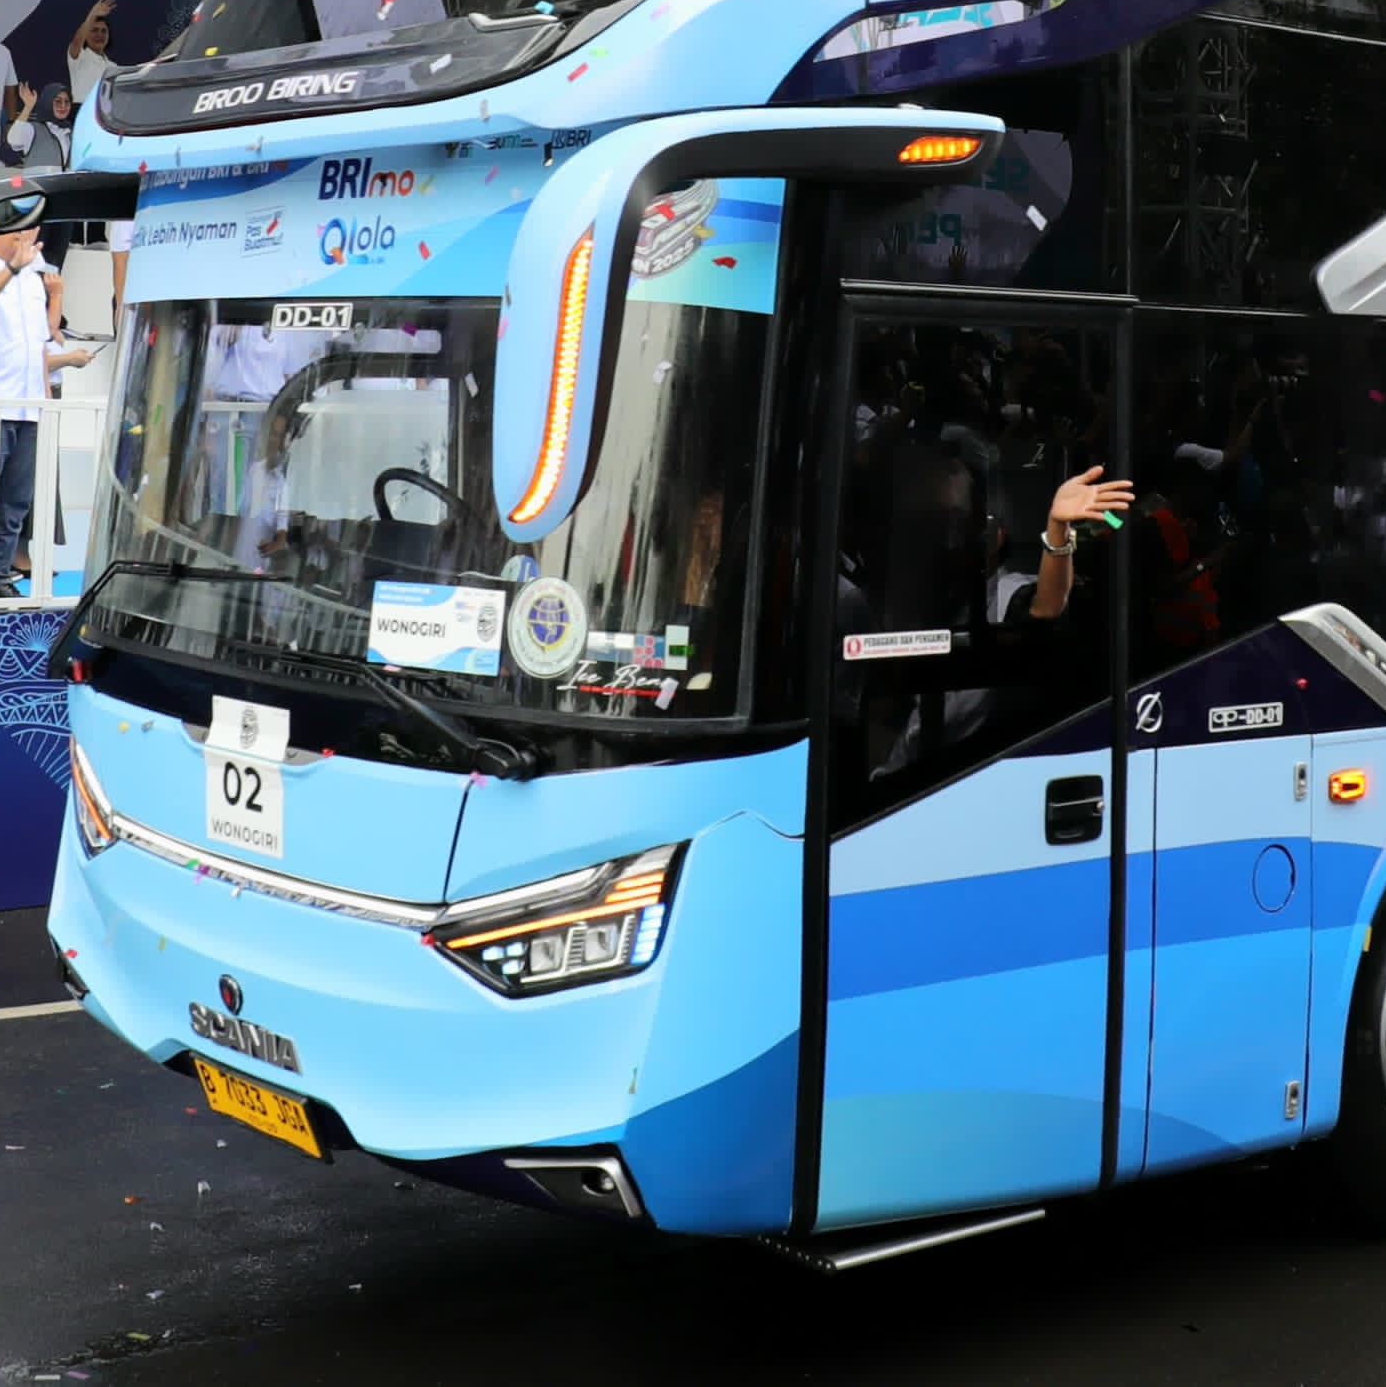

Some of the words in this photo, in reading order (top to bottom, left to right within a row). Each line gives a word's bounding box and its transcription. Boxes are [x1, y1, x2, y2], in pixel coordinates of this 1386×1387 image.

[193, 81, 261, 115] BROO
[264, 71, 361, 102] BIRING
[317, 157, 415, 201] BRImo
[147, 222, 178, 247] Lebih
[180, 221, 238, 250] Nyaman
[276, 305, 350, 329] DD-01
[376, 617, 447, 639] WONOGIRI
[222, 760, 264, 814] 02
[212, 817, 279, 851] WONOGIRI
[188, 1000, 303, 1077] SCANIA
